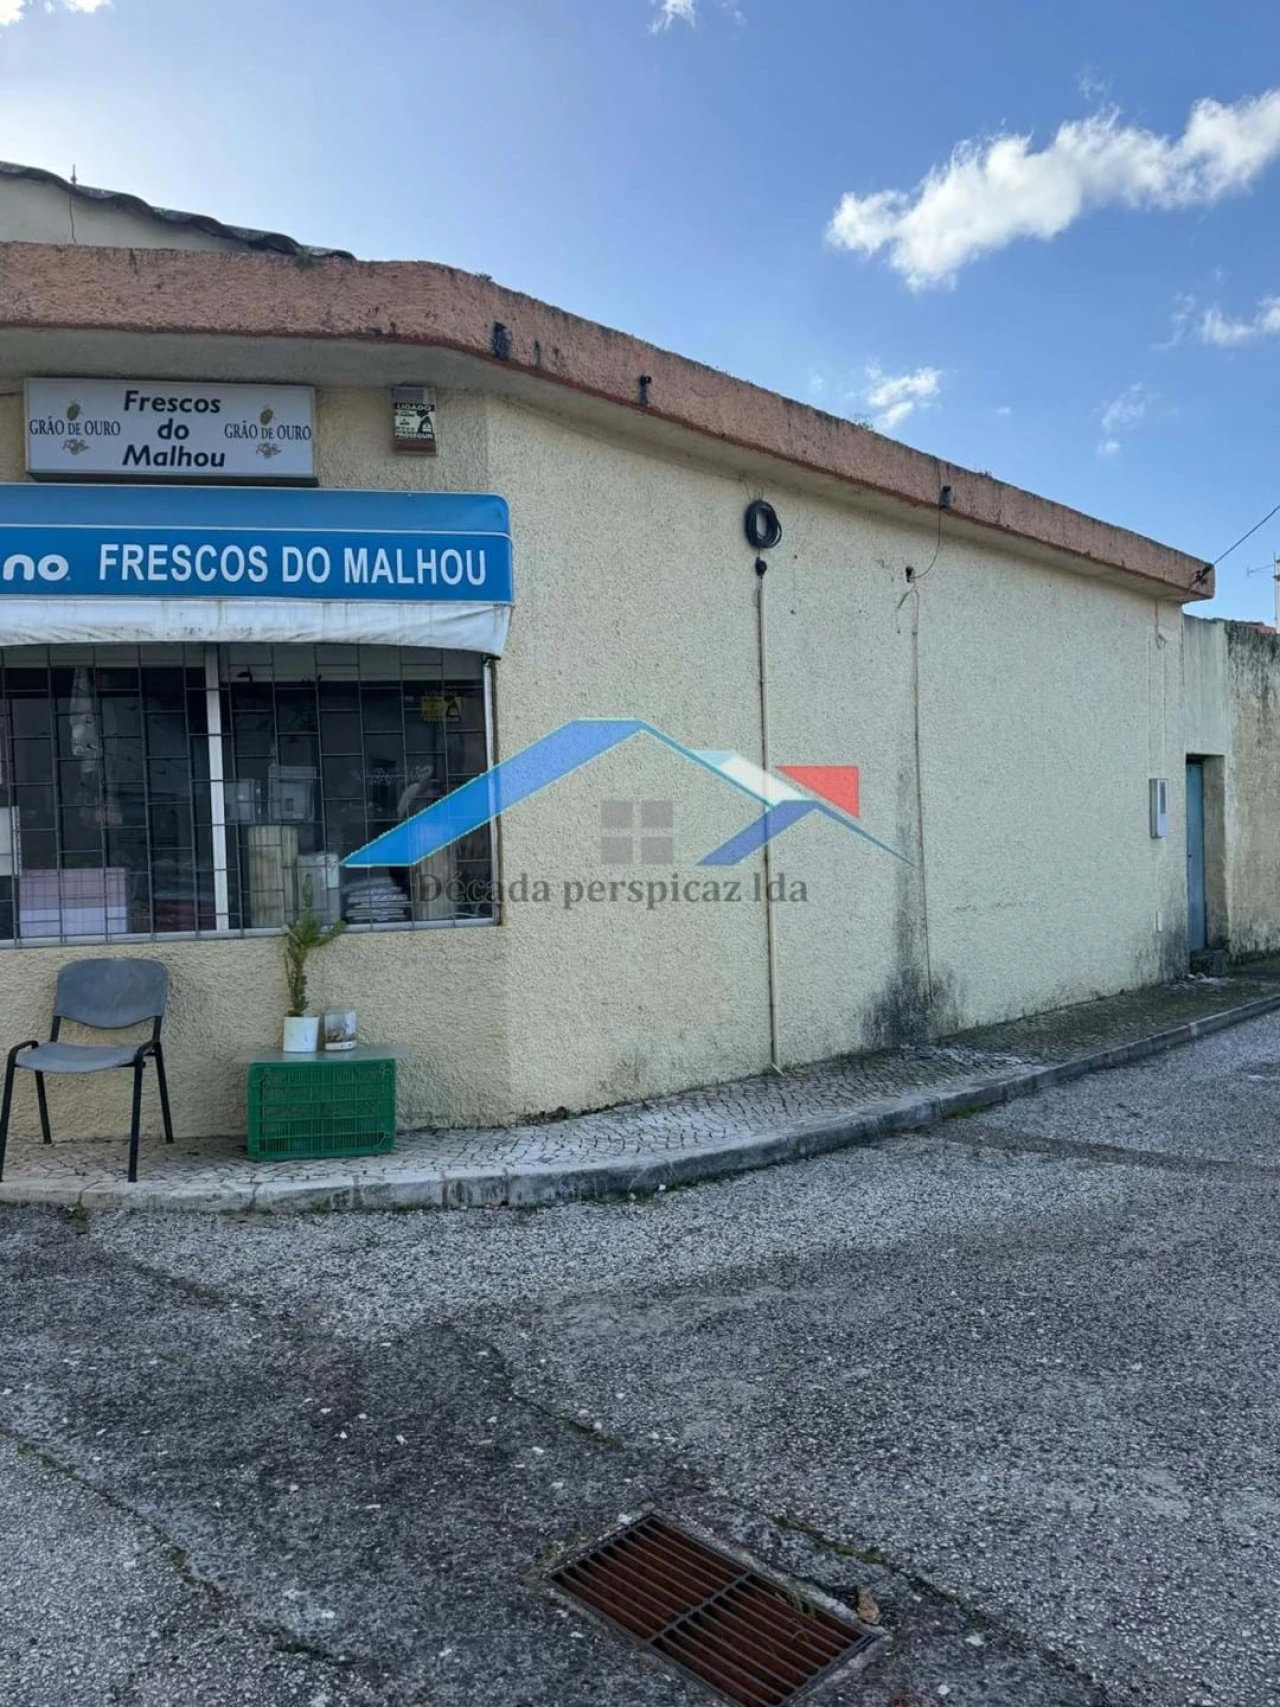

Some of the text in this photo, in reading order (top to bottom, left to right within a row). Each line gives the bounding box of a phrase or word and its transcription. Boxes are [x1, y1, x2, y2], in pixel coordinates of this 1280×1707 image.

[123, 390, 221, 414] Frescos
[29, 416, 121, 436] GRÃO DE OURO
[157, 418, 190, 440] do
[224, 420, 312, 440] GRÃO DE OURO
[122, 444, 226, 468] Malhou
[99, 542, 487, 587] FRESCOS DO MALHOU
